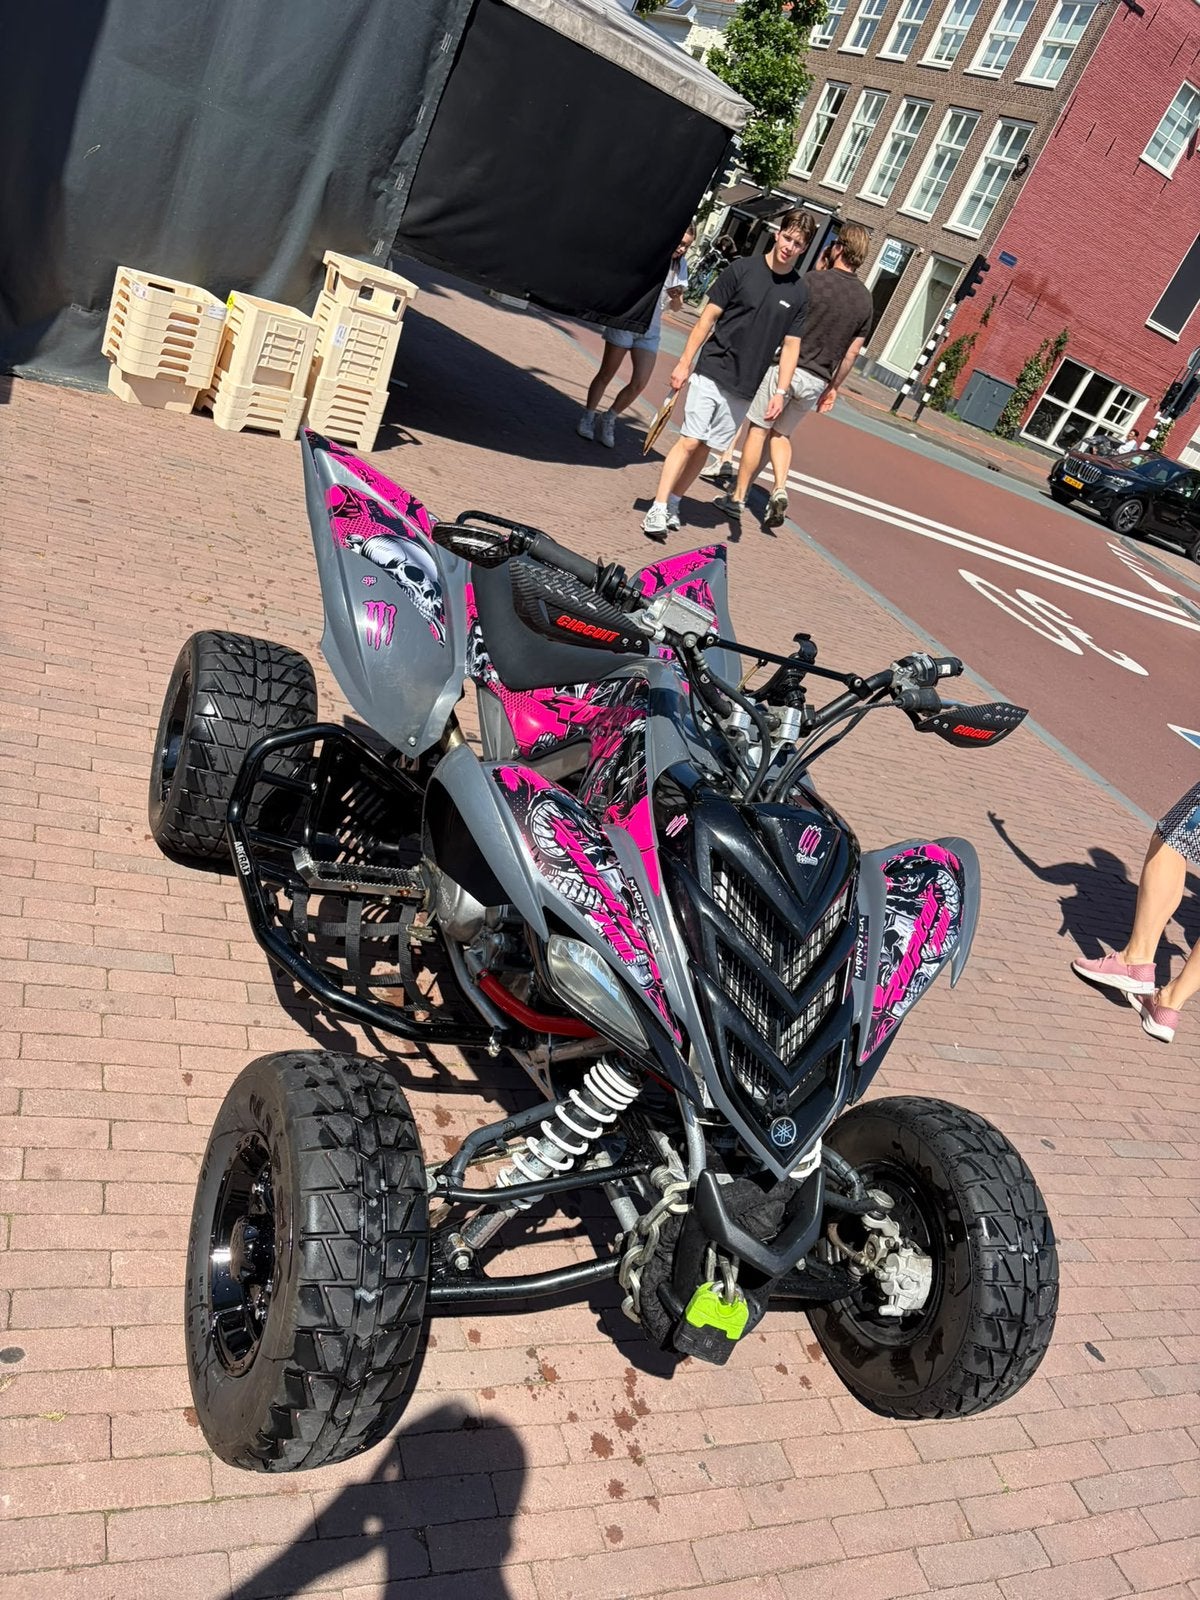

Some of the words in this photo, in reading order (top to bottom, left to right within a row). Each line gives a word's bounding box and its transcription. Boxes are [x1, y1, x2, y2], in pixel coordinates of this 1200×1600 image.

[556, 615, 620, 643] CIRCUIT
[953, 724, 997, 740] CIRCUIT
[233, 841, 252, 876] ARTRAX
[590, 902, 637, 963] 700
[930, 906, 951, 957] 700
